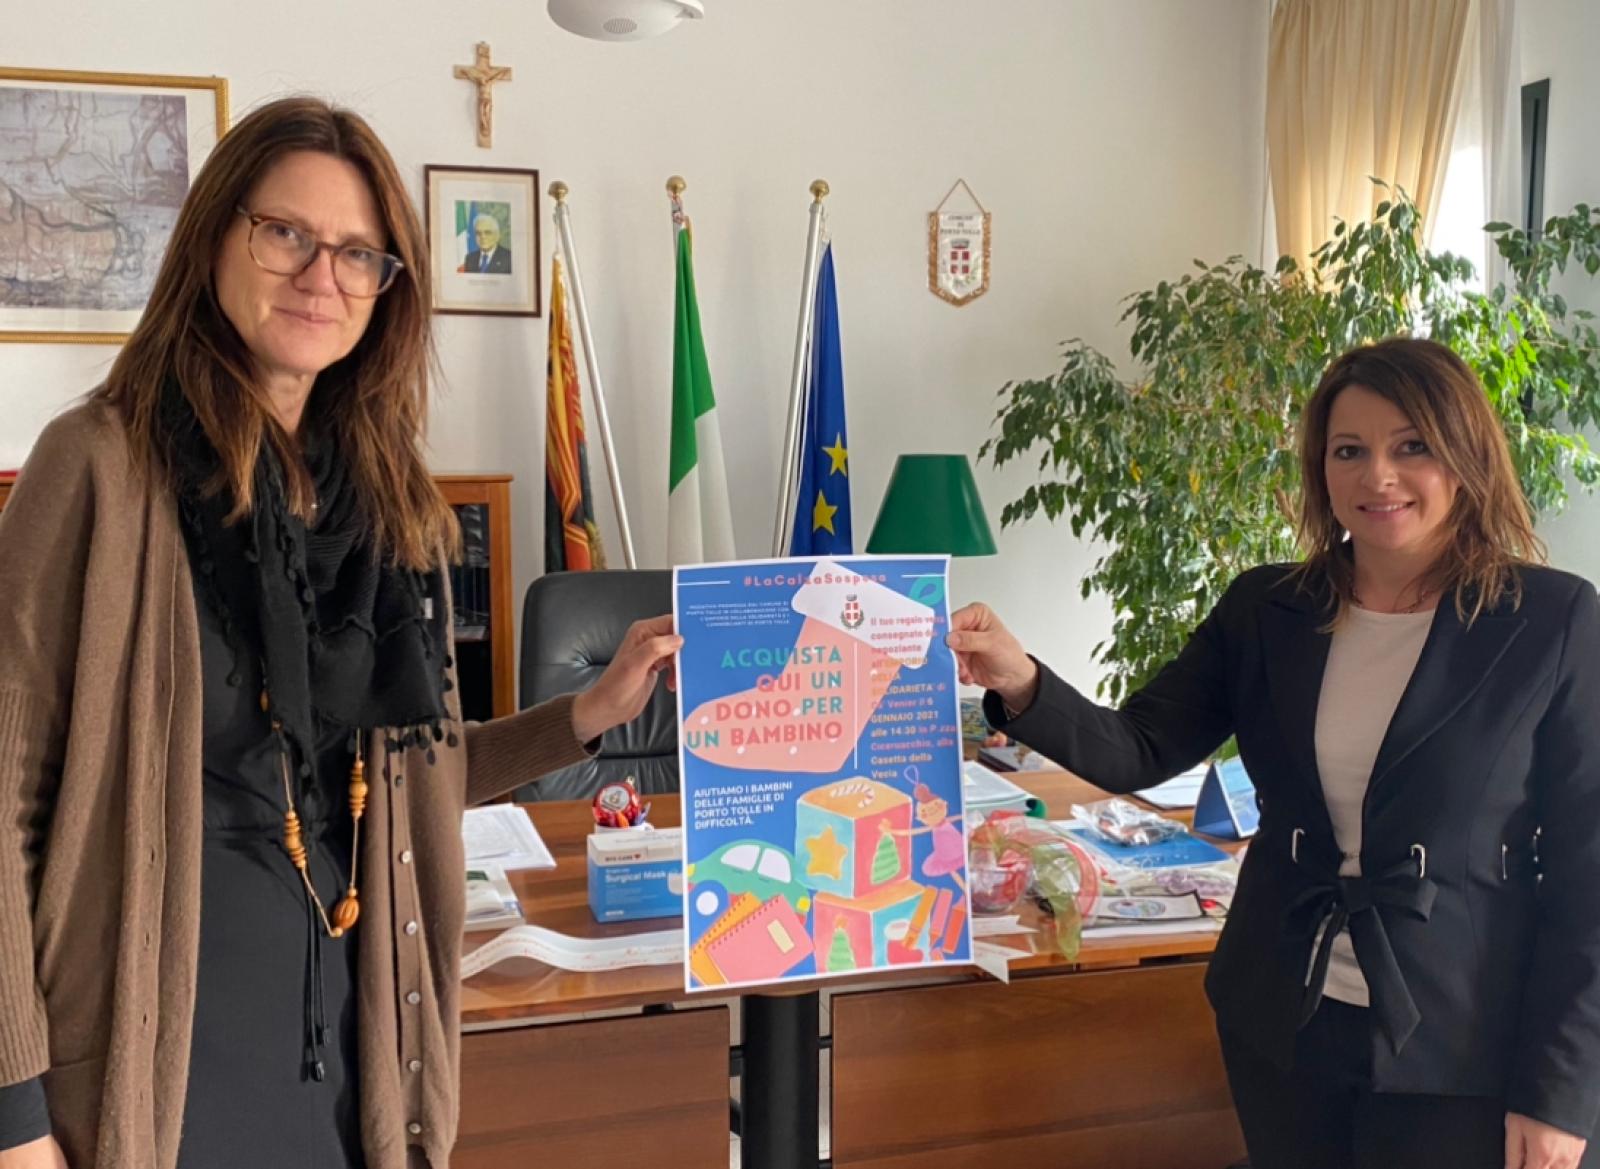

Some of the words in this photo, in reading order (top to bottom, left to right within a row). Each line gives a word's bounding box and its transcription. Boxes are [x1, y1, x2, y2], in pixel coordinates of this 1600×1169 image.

[880, 617, 894, 626] tuo
[896, 615, 922, 627] regalo
[871, 629, 923, 641] consegnato
[721, 646, 842, 668] ACQUISTA
[871, 644, 922, 656] negoziante
[757, 673, 801, 693] QUI
[811, 671, 842, 689] UN
[716, 699, 792, 722] DONO
[802, 696, 843, 716] PER
[871, 711, 914, 723] GENNAIO
[916, 710, 939, 721] 2021
[687, 729, 720, 749] UN
[731, 721, 842, 746] BAMBINO
[871, 728, 888, 738] alle
[871, 754, 906, 765] Casetta
[909, 753, 932, 762] della
[694, 785, 743, 798] AIUTIAMO
[751, 781, 792, 793] BAMBINI
[694, 798, 724, 809] DELLE
[726, 793, 771, 806] FAMIGLIE
[773, 792, 785, 802] DI
[694, 808, 729, 819] PORTO
[730, 804, 761, 816] TOLLE
[763, 803, 775, 813] IN
[605, 873, 642, 884] Surgical
[643, 870, 666, 880] Mask
